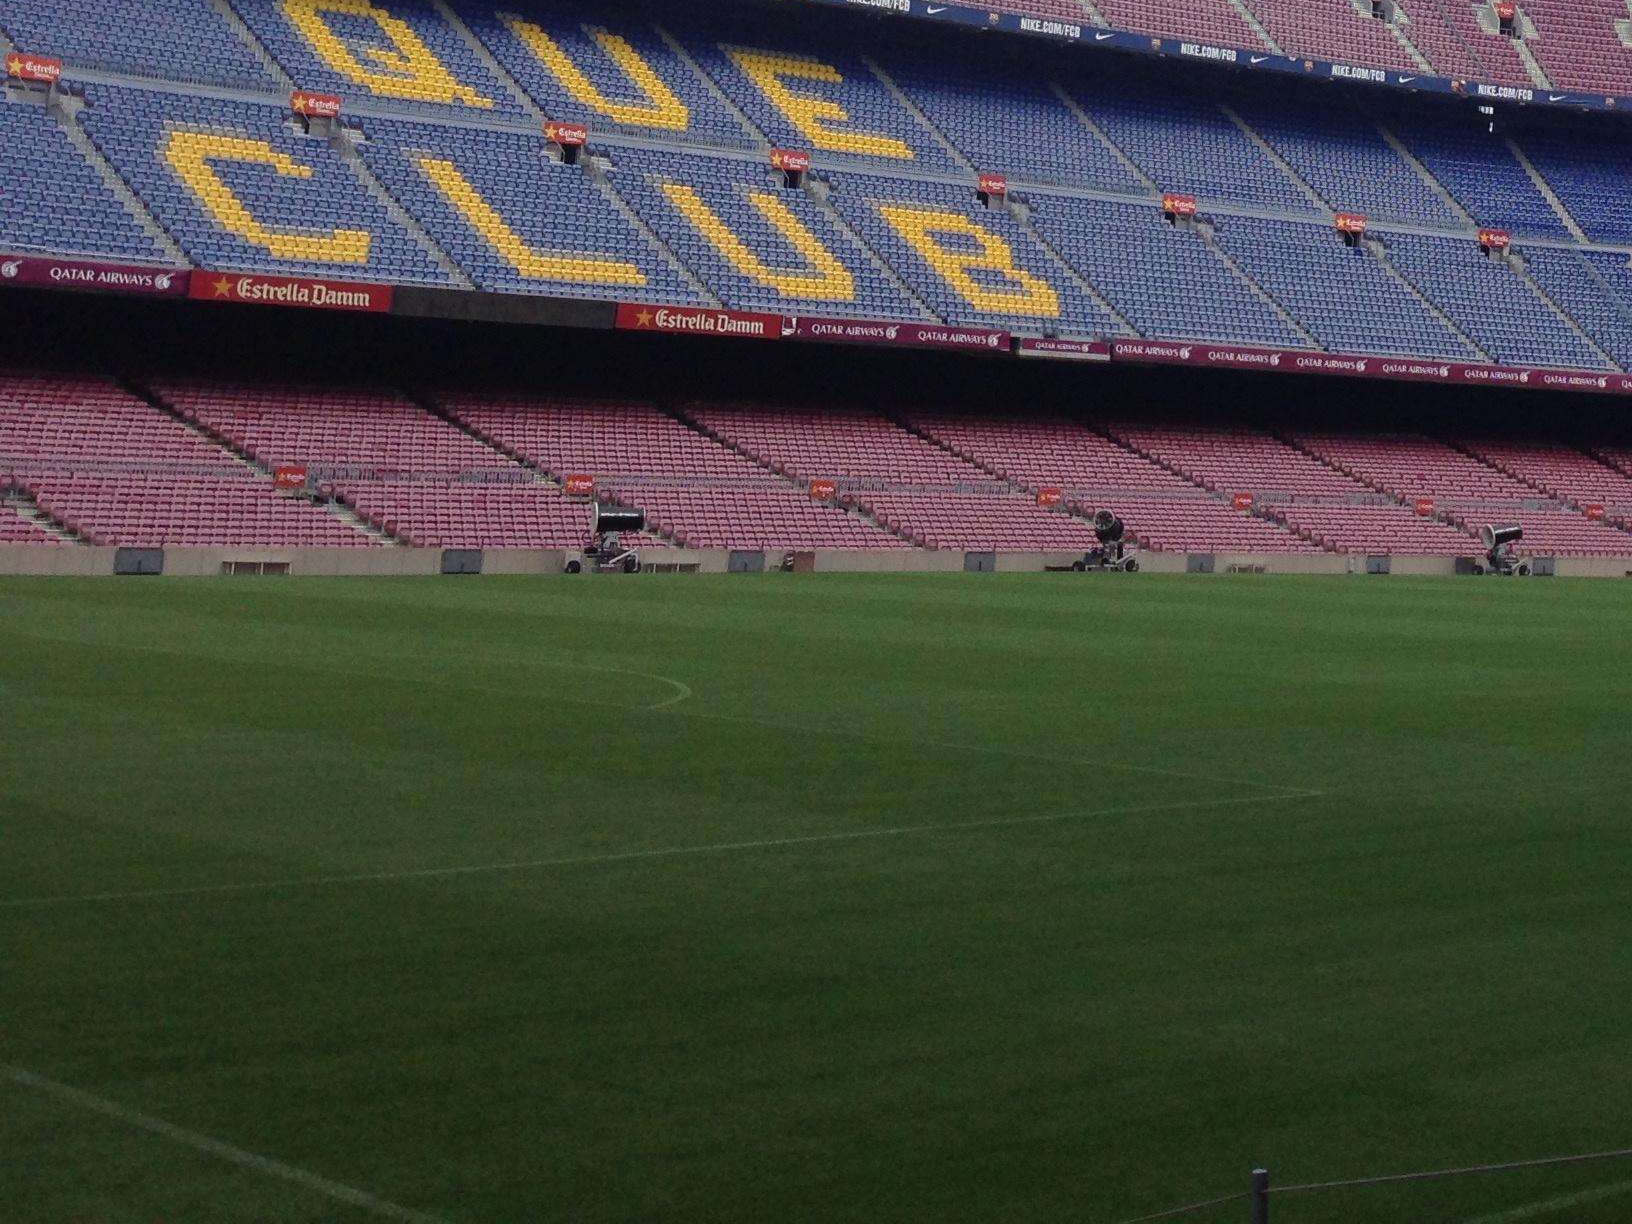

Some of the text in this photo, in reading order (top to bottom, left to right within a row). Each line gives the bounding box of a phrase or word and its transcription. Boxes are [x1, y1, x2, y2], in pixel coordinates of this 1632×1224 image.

[1020, 17, 1081, 38] NIKE.COM/FCB
[1180, 42, 1237, 62] NIKE.COM/FCB
[1331, 64, 1386, 82] NIKE.COM/FCB
[1478, 84, 1533, 101] NIKE.COM/FCB
[165, 130, 1062, 318] CLUB
[50, 267, 152, 286] QATAR AIRWAYS
[237, 277, 370, 306] Estrella Damm
[655, 308, 764, 334] Estrella Damm
[811, 323, 885, 337] QATAR AIRWAYS
[918, 330, 986, 344] QATAR AIRWAYS
[1115, 344, 1179, 357] QATAR AIRWAYS
[1208, 351, 1269, 364] QATAR AIRWAYS
[1296, 357, 1356, 370] QATAR AIRWAYS
[1382, 364, 1439, 376] QATAR AIRWAYS
[1464, 369, 1488, 379] QATAR
[1544, 375, 1567, 385] QATAR
